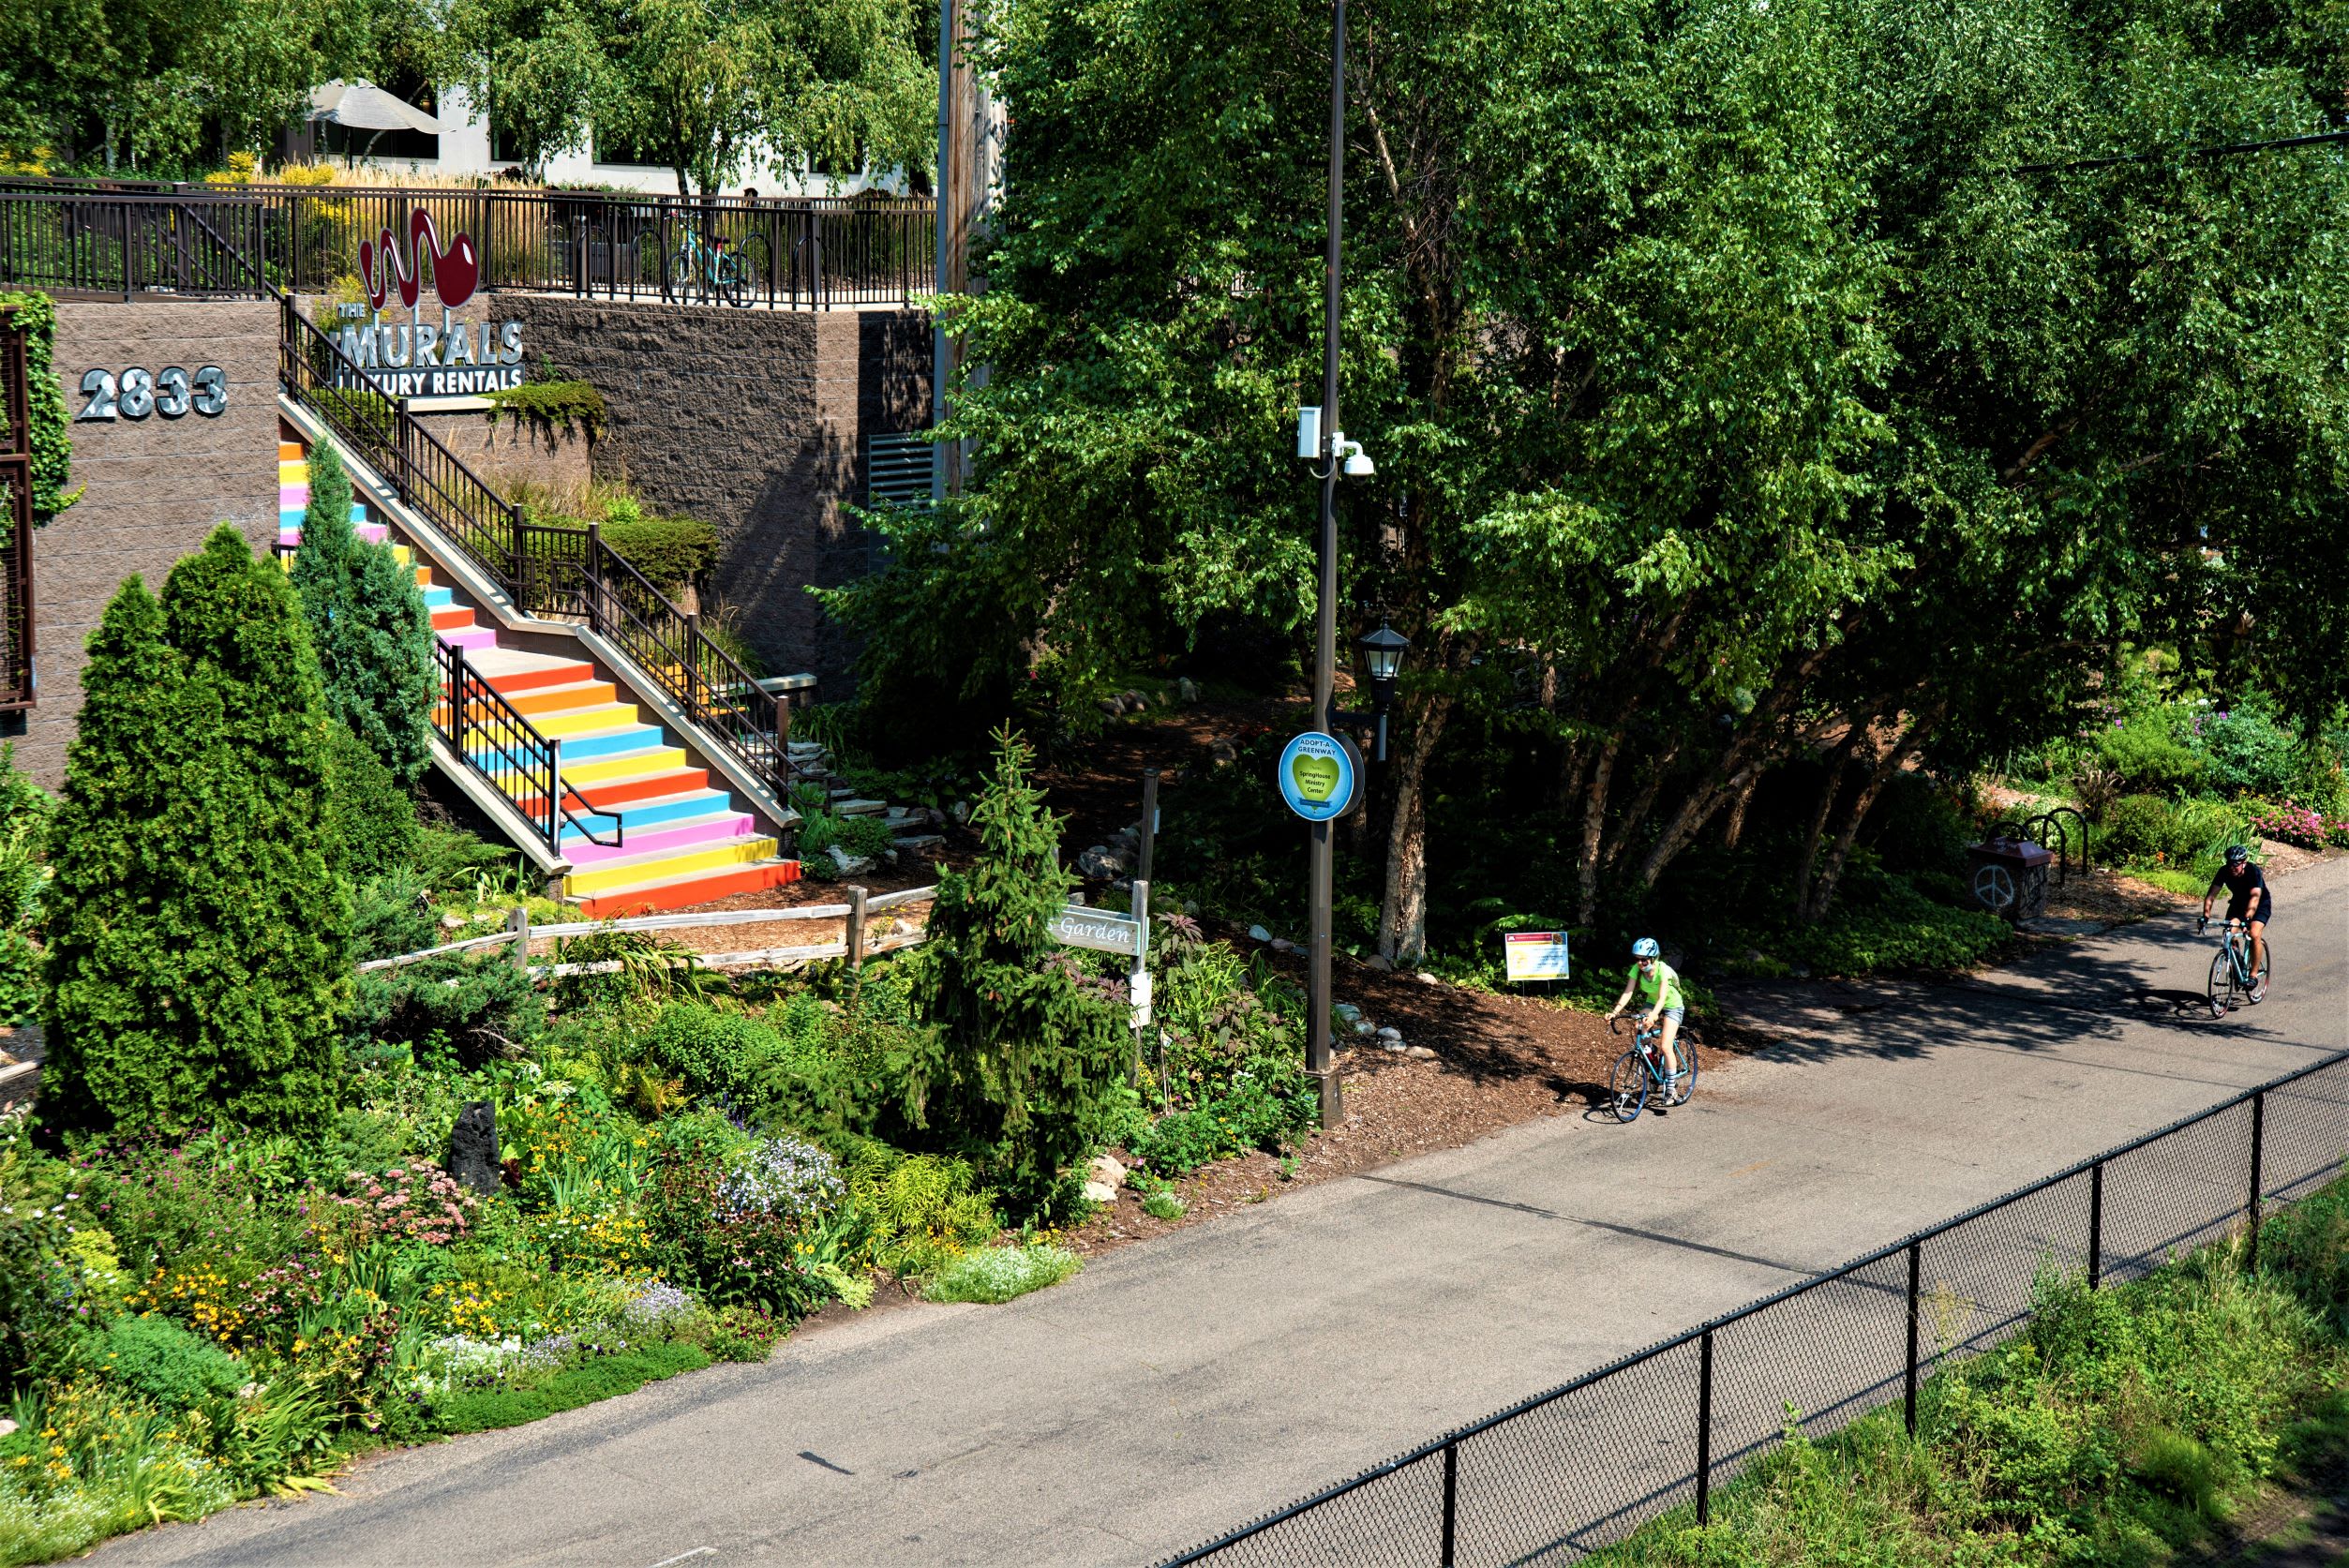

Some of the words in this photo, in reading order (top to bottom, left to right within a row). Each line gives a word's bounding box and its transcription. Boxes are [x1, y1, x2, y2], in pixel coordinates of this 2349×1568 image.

[337, 303, 366, 318] THE
[340, 321, 524, 368] MURALS
[432, 368, 522, 394] RENTALS
[74, 365, 228, 424] 2833
[1297, 746, 1336, 755] GREENWAY
[1305, 779, 1324, 787] Ministry
[1060, 918, 1130, 943] Garden
